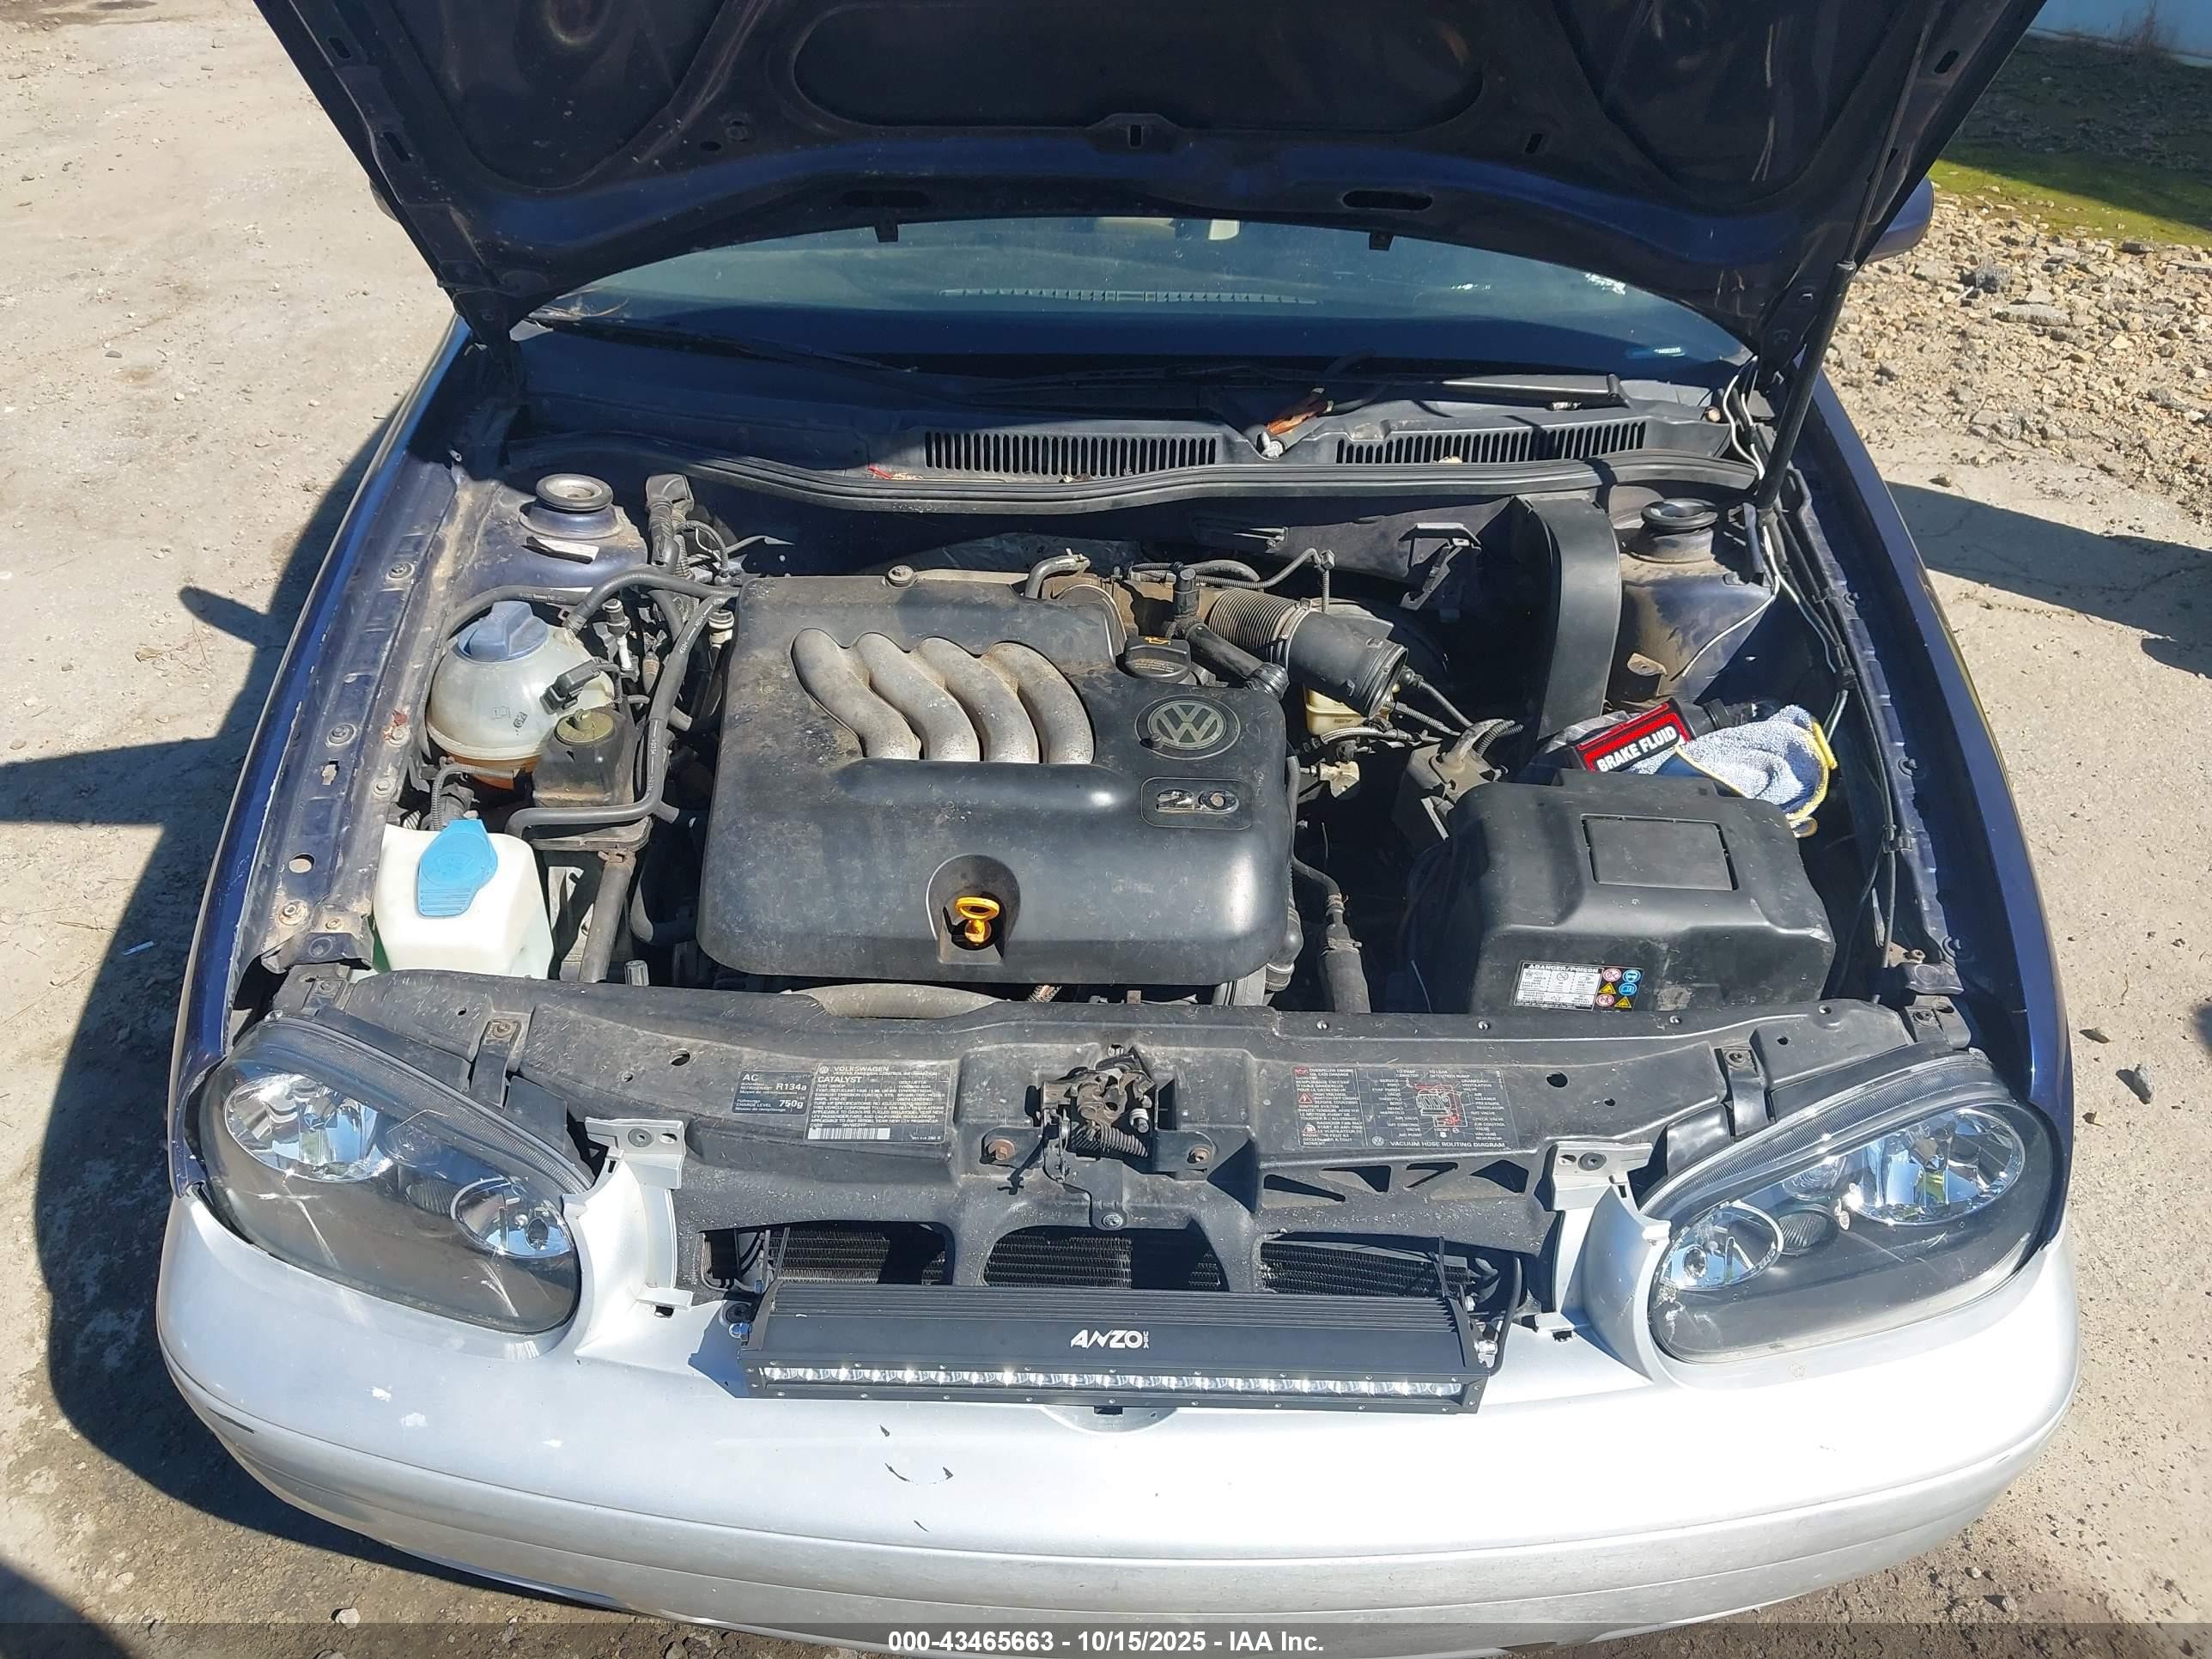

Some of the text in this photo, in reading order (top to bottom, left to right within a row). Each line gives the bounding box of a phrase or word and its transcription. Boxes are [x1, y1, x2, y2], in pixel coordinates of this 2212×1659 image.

[1596, 726, 1677, 772] BRAKE FLUID
[775, 1083, 807, 1091] R134a
[779, 1100, 804, 1109] 750g
[1070, 1329, 1143, 1349] ANZO
